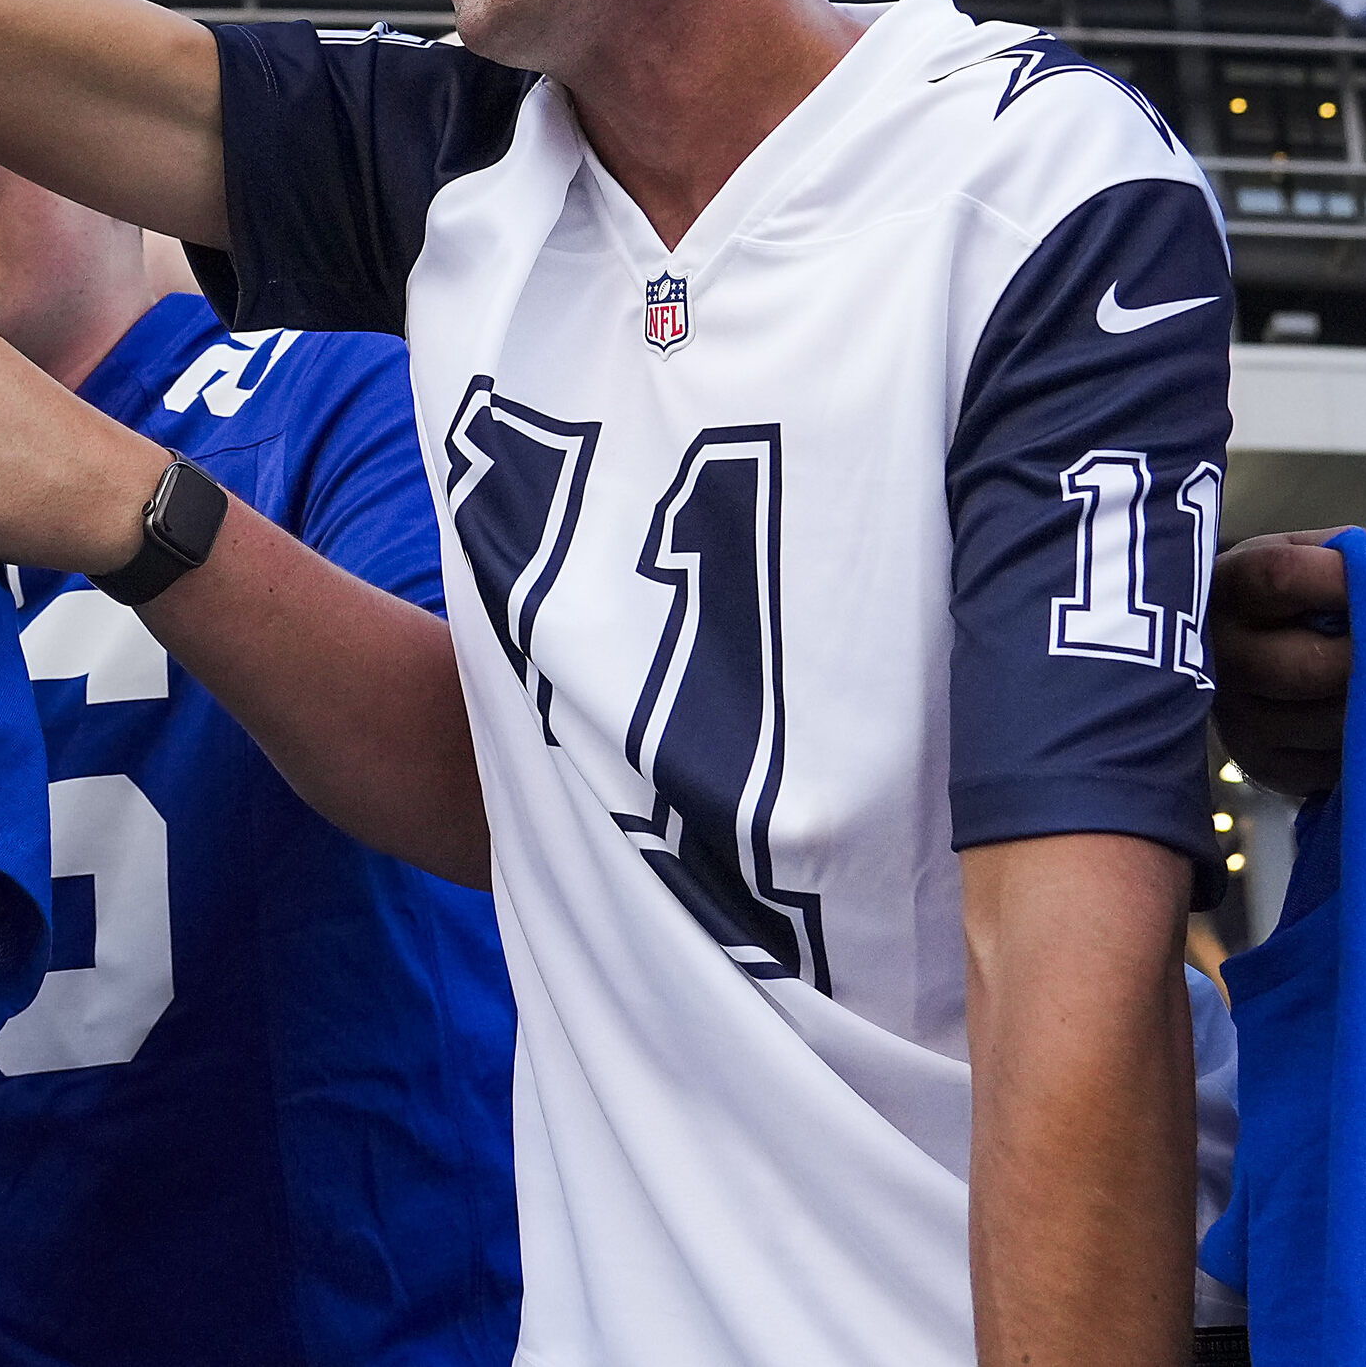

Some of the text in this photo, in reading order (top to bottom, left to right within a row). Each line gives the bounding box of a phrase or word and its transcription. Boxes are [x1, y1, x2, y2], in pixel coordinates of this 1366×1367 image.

[648, 305, 684, 342] NFL
[444, 374, 833, 1000] 11
[1048, 449, 1223, 691] 11
